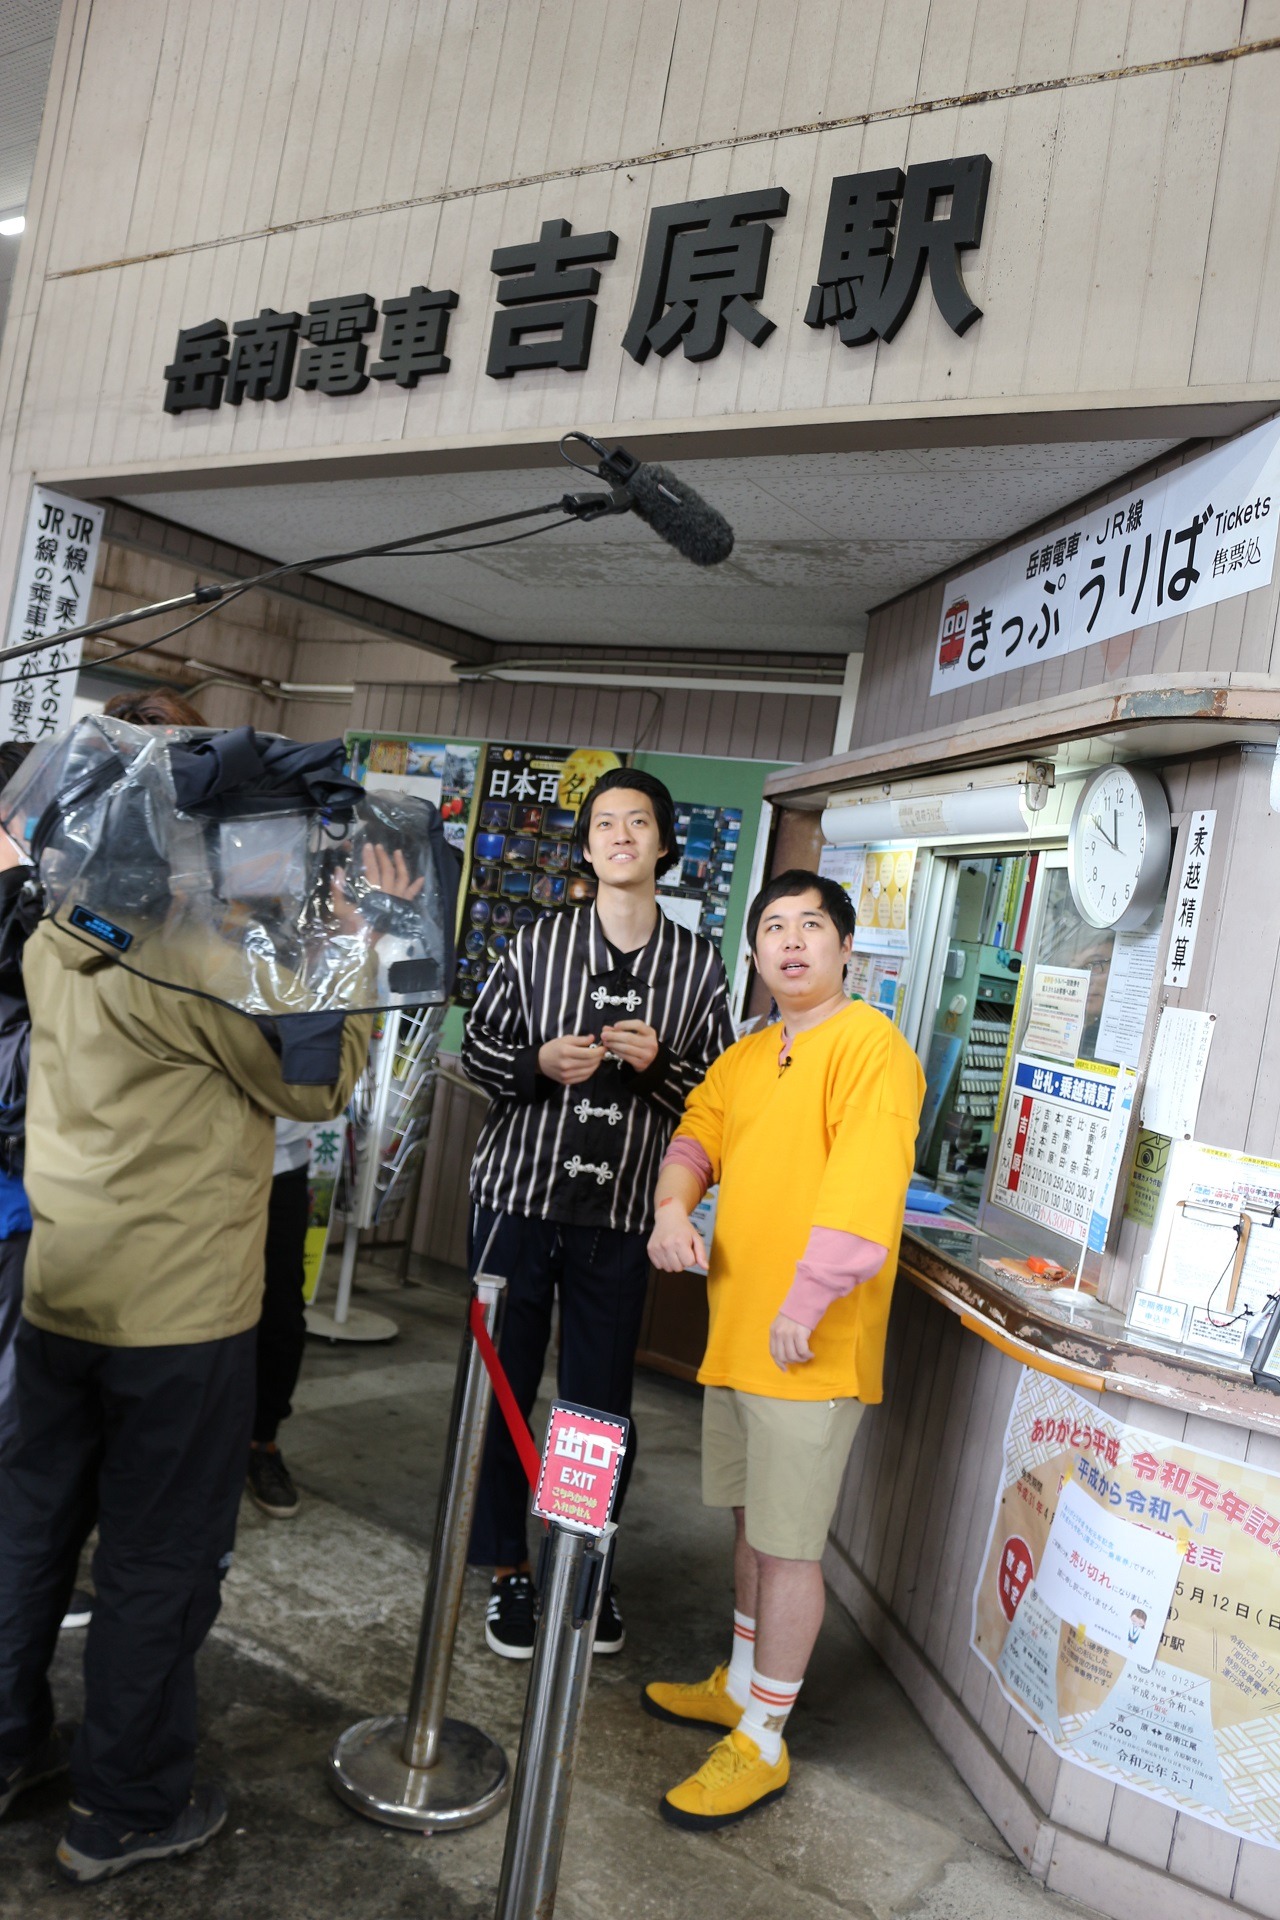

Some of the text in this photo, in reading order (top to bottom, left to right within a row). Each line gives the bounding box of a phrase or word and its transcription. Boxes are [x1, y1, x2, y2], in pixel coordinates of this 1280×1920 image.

[164, 154, 992, 415] 岳南電車 吉原駅
[1214, 496, 1271, 537] Tickets
[1026, 499, 1144, 580] 岳南電車・JR線
[967, 504, 1214, 671] きっぷうりば
[489, 767, 600, 804] 日本百名
[1115, 788, 1124, 803] 12
[1104, 796, 1111, 811] 11
[1130, 794, 1134, 808] 1
[1138, 812, 1143, 827] 2
[1091, 841, 1096, 856] 9
[1092, 867, 1097, 881] 8
[1100, 885, 1106, 900] 7
[1111, 892, 1117, 907] 6
[1124, 884, 1130, 900] 5
[1171, 827, 1208, 971] 乗越精算
[314, 1130, 341, 1165] 茶
[554, 1426, 612, 1470] 出口
[1031, 1419, 1121, 1468] ありがとう平成
[560, 1466, 597, 1491] EXIT
[1171, 1674, 1196, 1689] 0123
[1117, 1748, 1168, 1778] 令和元年
